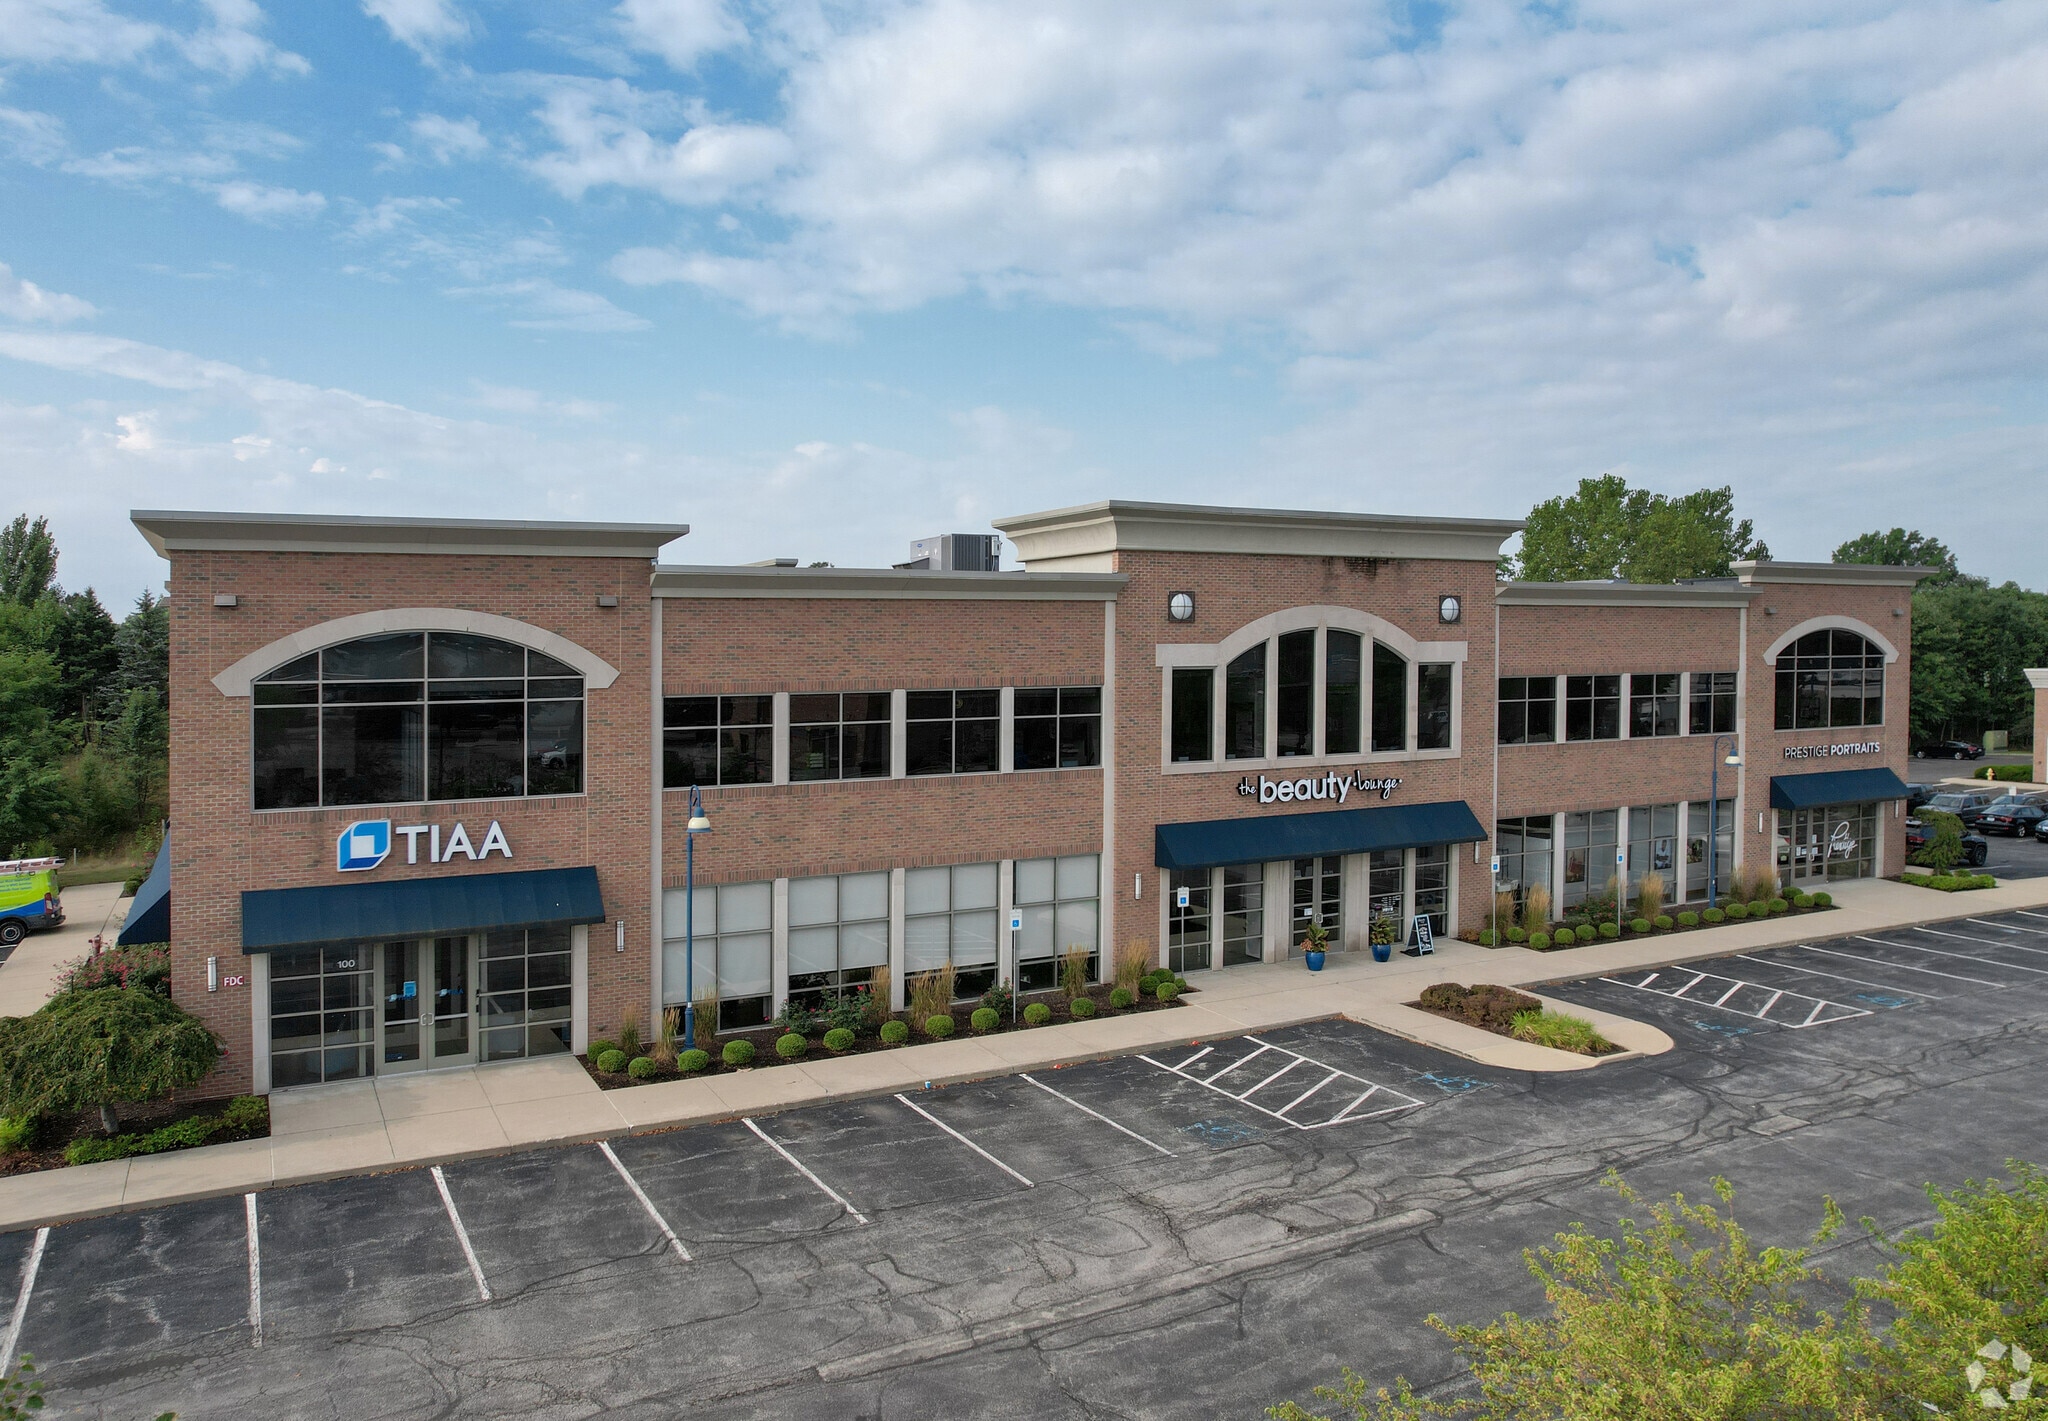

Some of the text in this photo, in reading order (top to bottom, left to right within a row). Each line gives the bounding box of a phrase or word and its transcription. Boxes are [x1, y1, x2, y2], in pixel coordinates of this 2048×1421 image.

[1784, 742, 1880, 758] PRESTIGE PORTRAITS
[1238, 777, 1257, 796] the
[1259, 771, 1352, 803] beauty
[395, 820, 513, 865] TIAA
[336, 960, 356, 969] 100
[223, 975, 244, 987] FDC
